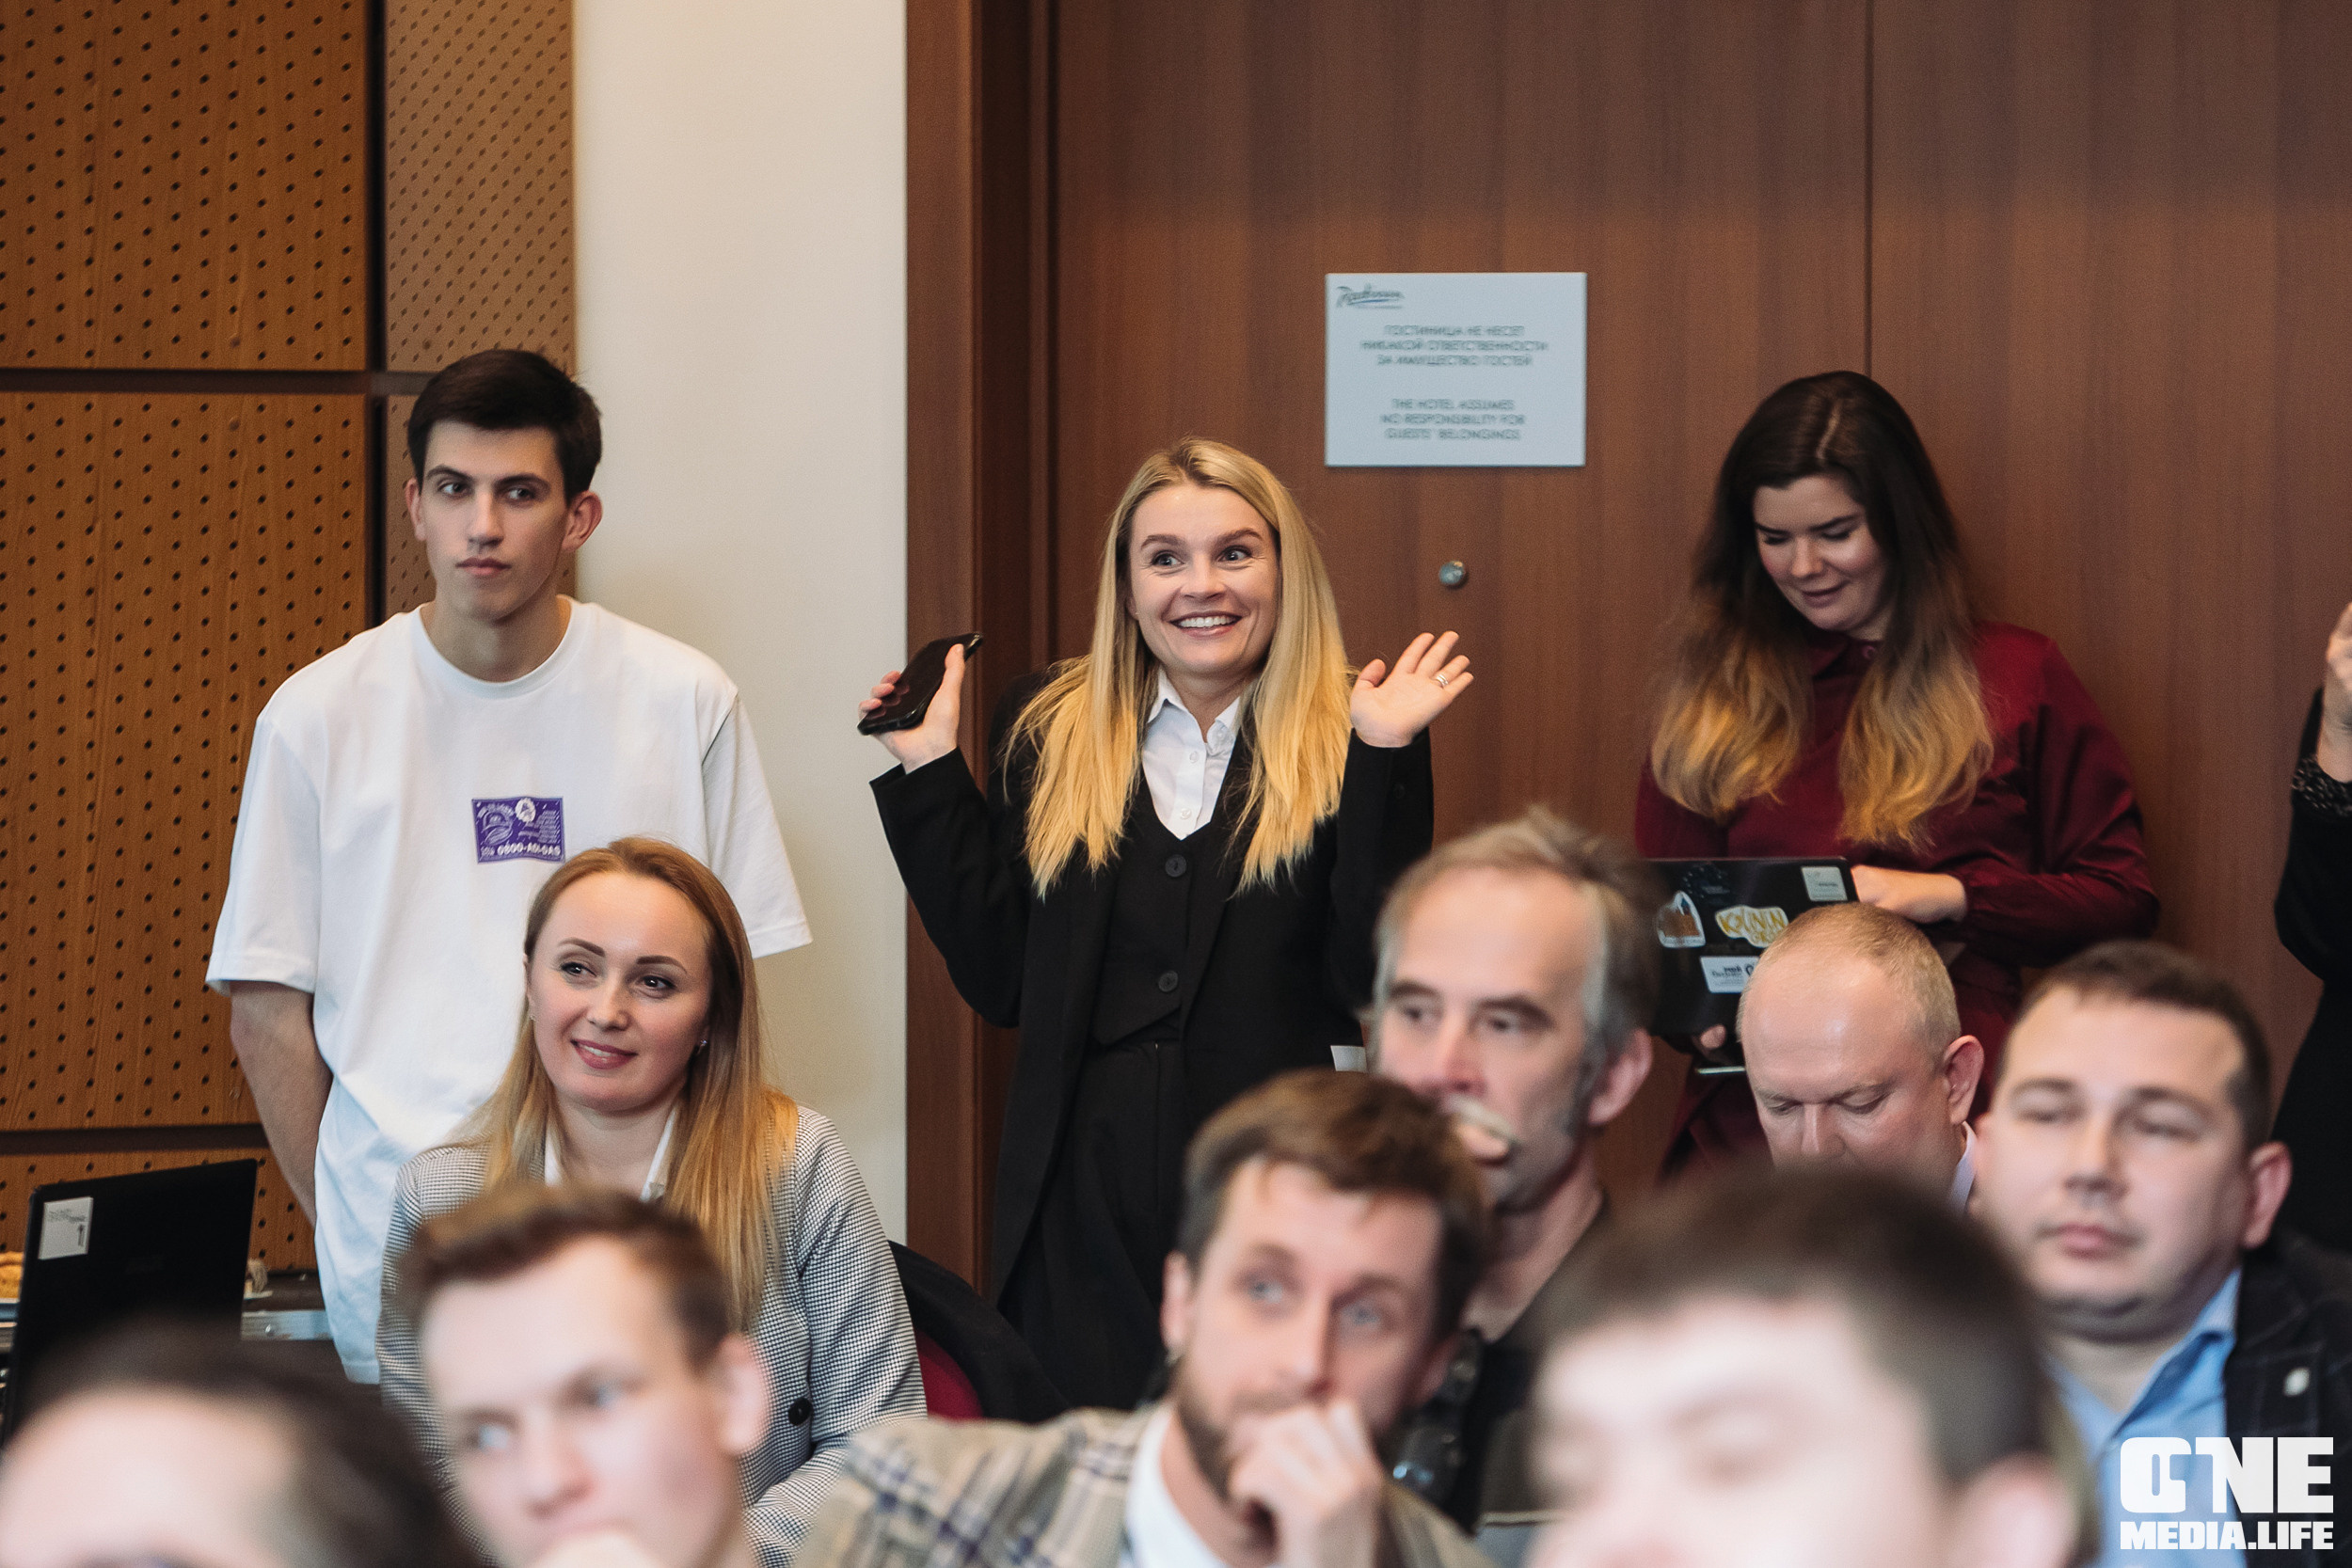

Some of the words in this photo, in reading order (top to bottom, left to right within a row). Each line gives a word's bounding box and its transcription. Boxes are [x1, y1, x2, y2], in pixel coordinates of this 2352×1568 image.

[1384, 325, 1462, 336] ГОСТИНИЦА
[1467, 325, 1482, 336] НЕ
[1486, 325, 1525, 337] НЕСЕТ
[1360, 339, 1422, 351] НИКАКОЙ
[1426, 340, 1549, 351] ОТВЕТСТВЕННОСТИ
[1377, 355, 1392, 366] ЗА
[1397, 355, 1478, 366] ИМУЩЕСТВО
[1484, 354, 1533, 366] ГОСТЕЙ
[1391, 398, 1413, 409] THE
[1417, 399, 1454, 410] HOTEL
[1458, 399, 1516, 410] ASSUMES
[1380, 414, 1403, 424] NO
[1404, 414, 1497, 424] RESPONSIBILITY
[1500, 414, 1525, 425] FOR
[1438, 428, 1520, 439] BELONGINGS
